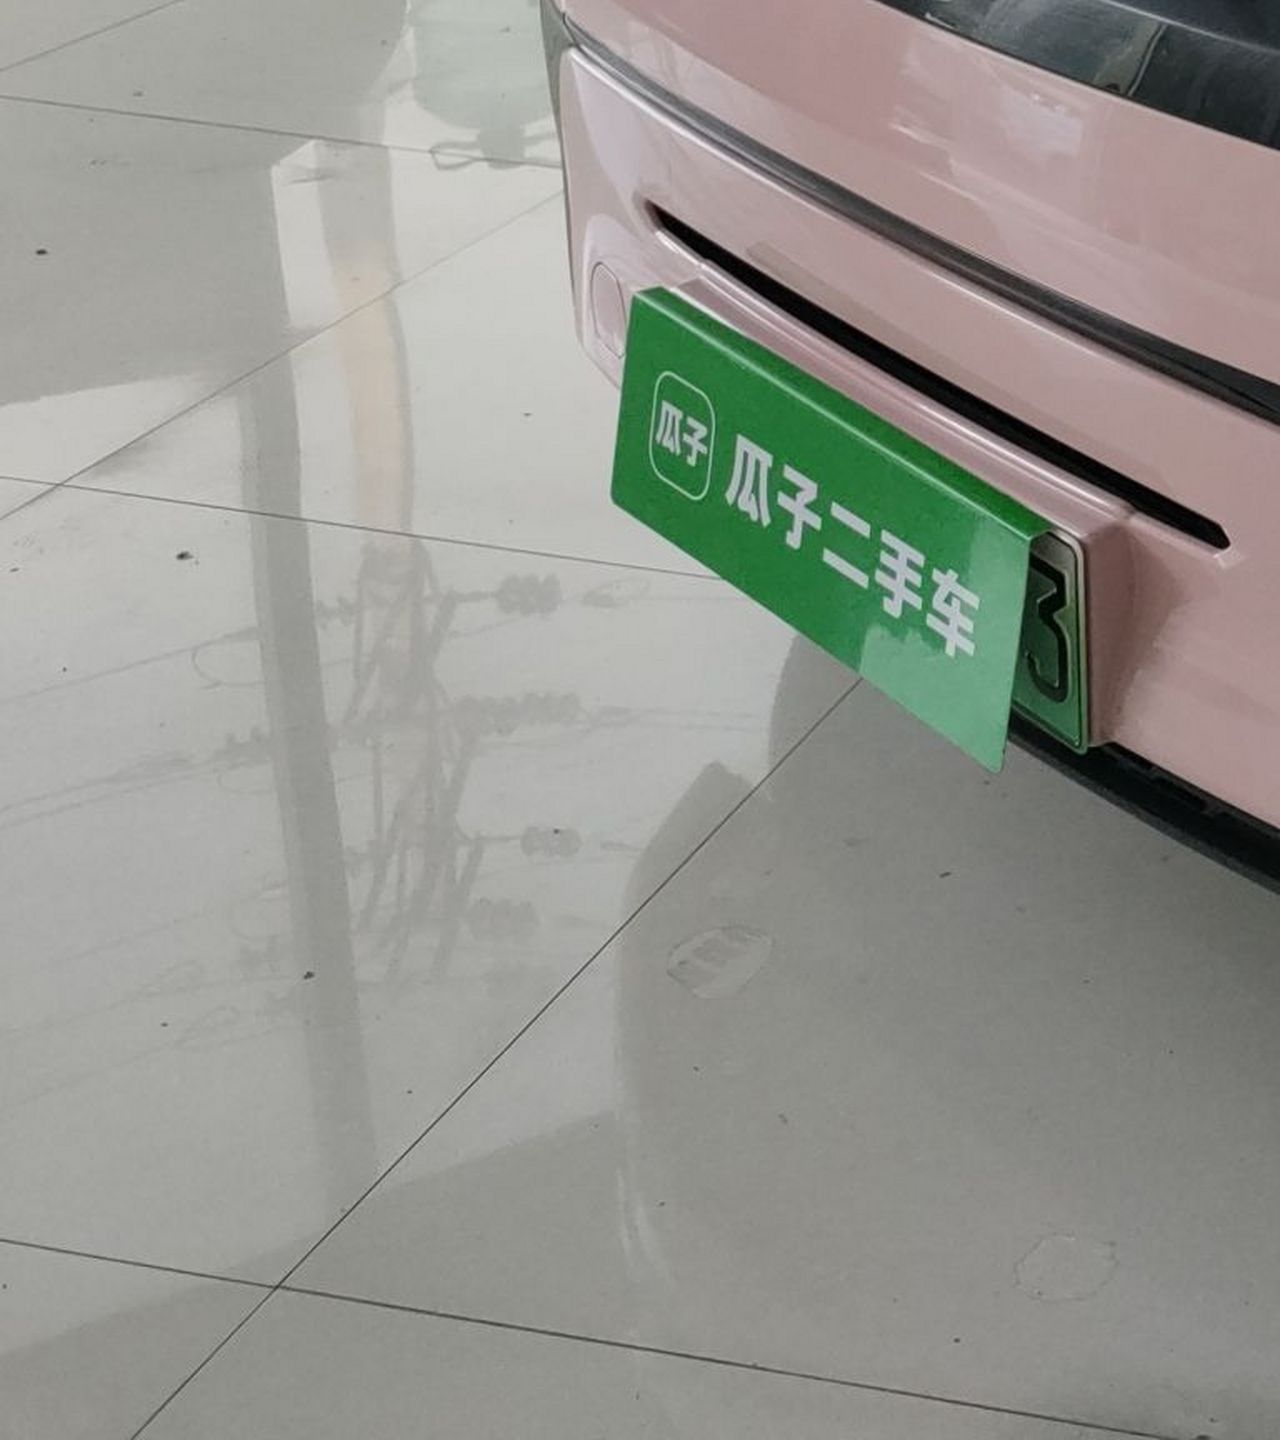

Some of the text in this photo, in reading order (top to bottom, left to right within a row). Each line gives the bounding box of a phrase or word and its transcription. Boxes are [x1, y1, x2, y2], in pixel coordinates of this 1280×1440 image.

[655, 399, 709, 467] 瓜子
[725, 433, 981, 658] 瓜子二手车
